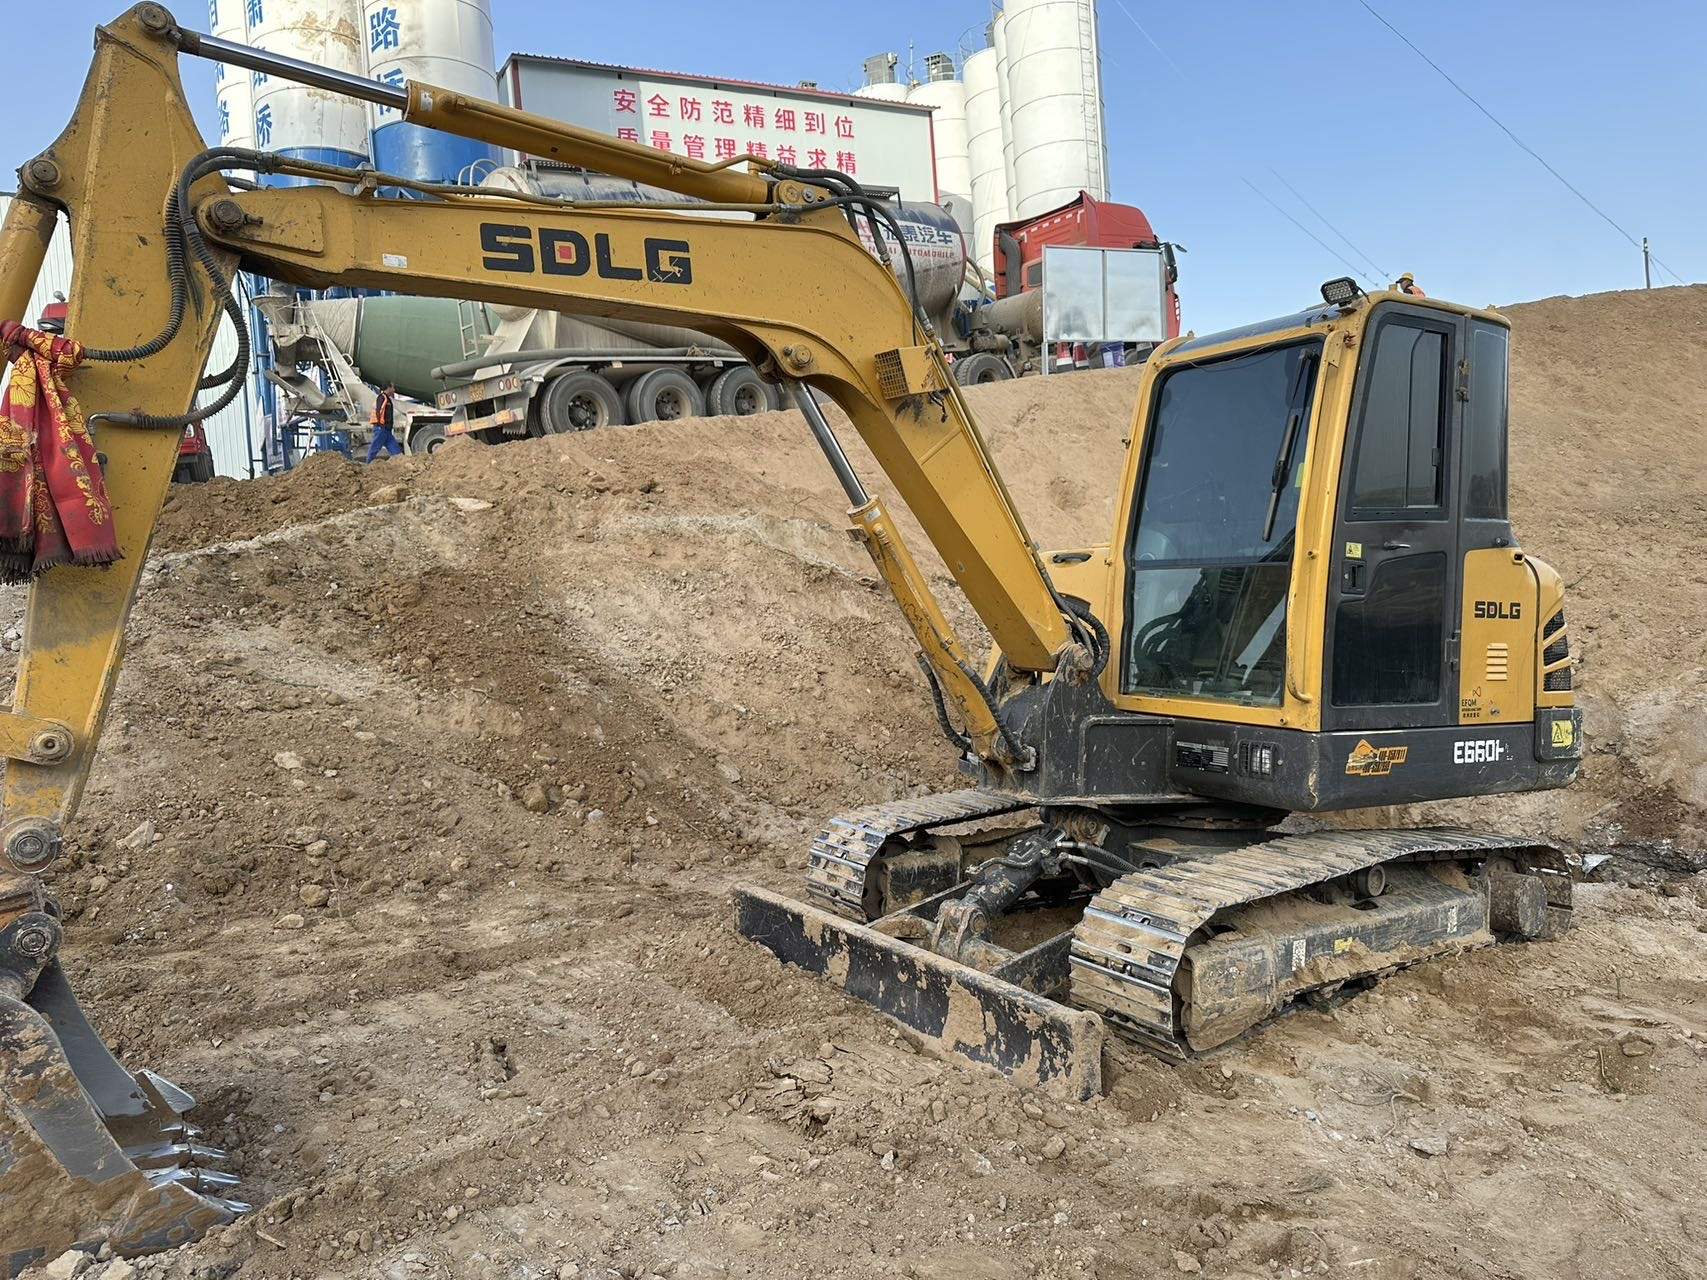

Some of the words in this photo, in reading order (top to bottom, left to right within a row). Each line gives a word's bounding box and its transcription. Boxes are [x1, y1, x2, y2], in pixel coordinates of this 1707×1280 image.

[613, 89, 855, 139] 安全防范精细到位
[480, 223, 692, 285] SDLG
[1474, 601, 1521, 619] SDLG
